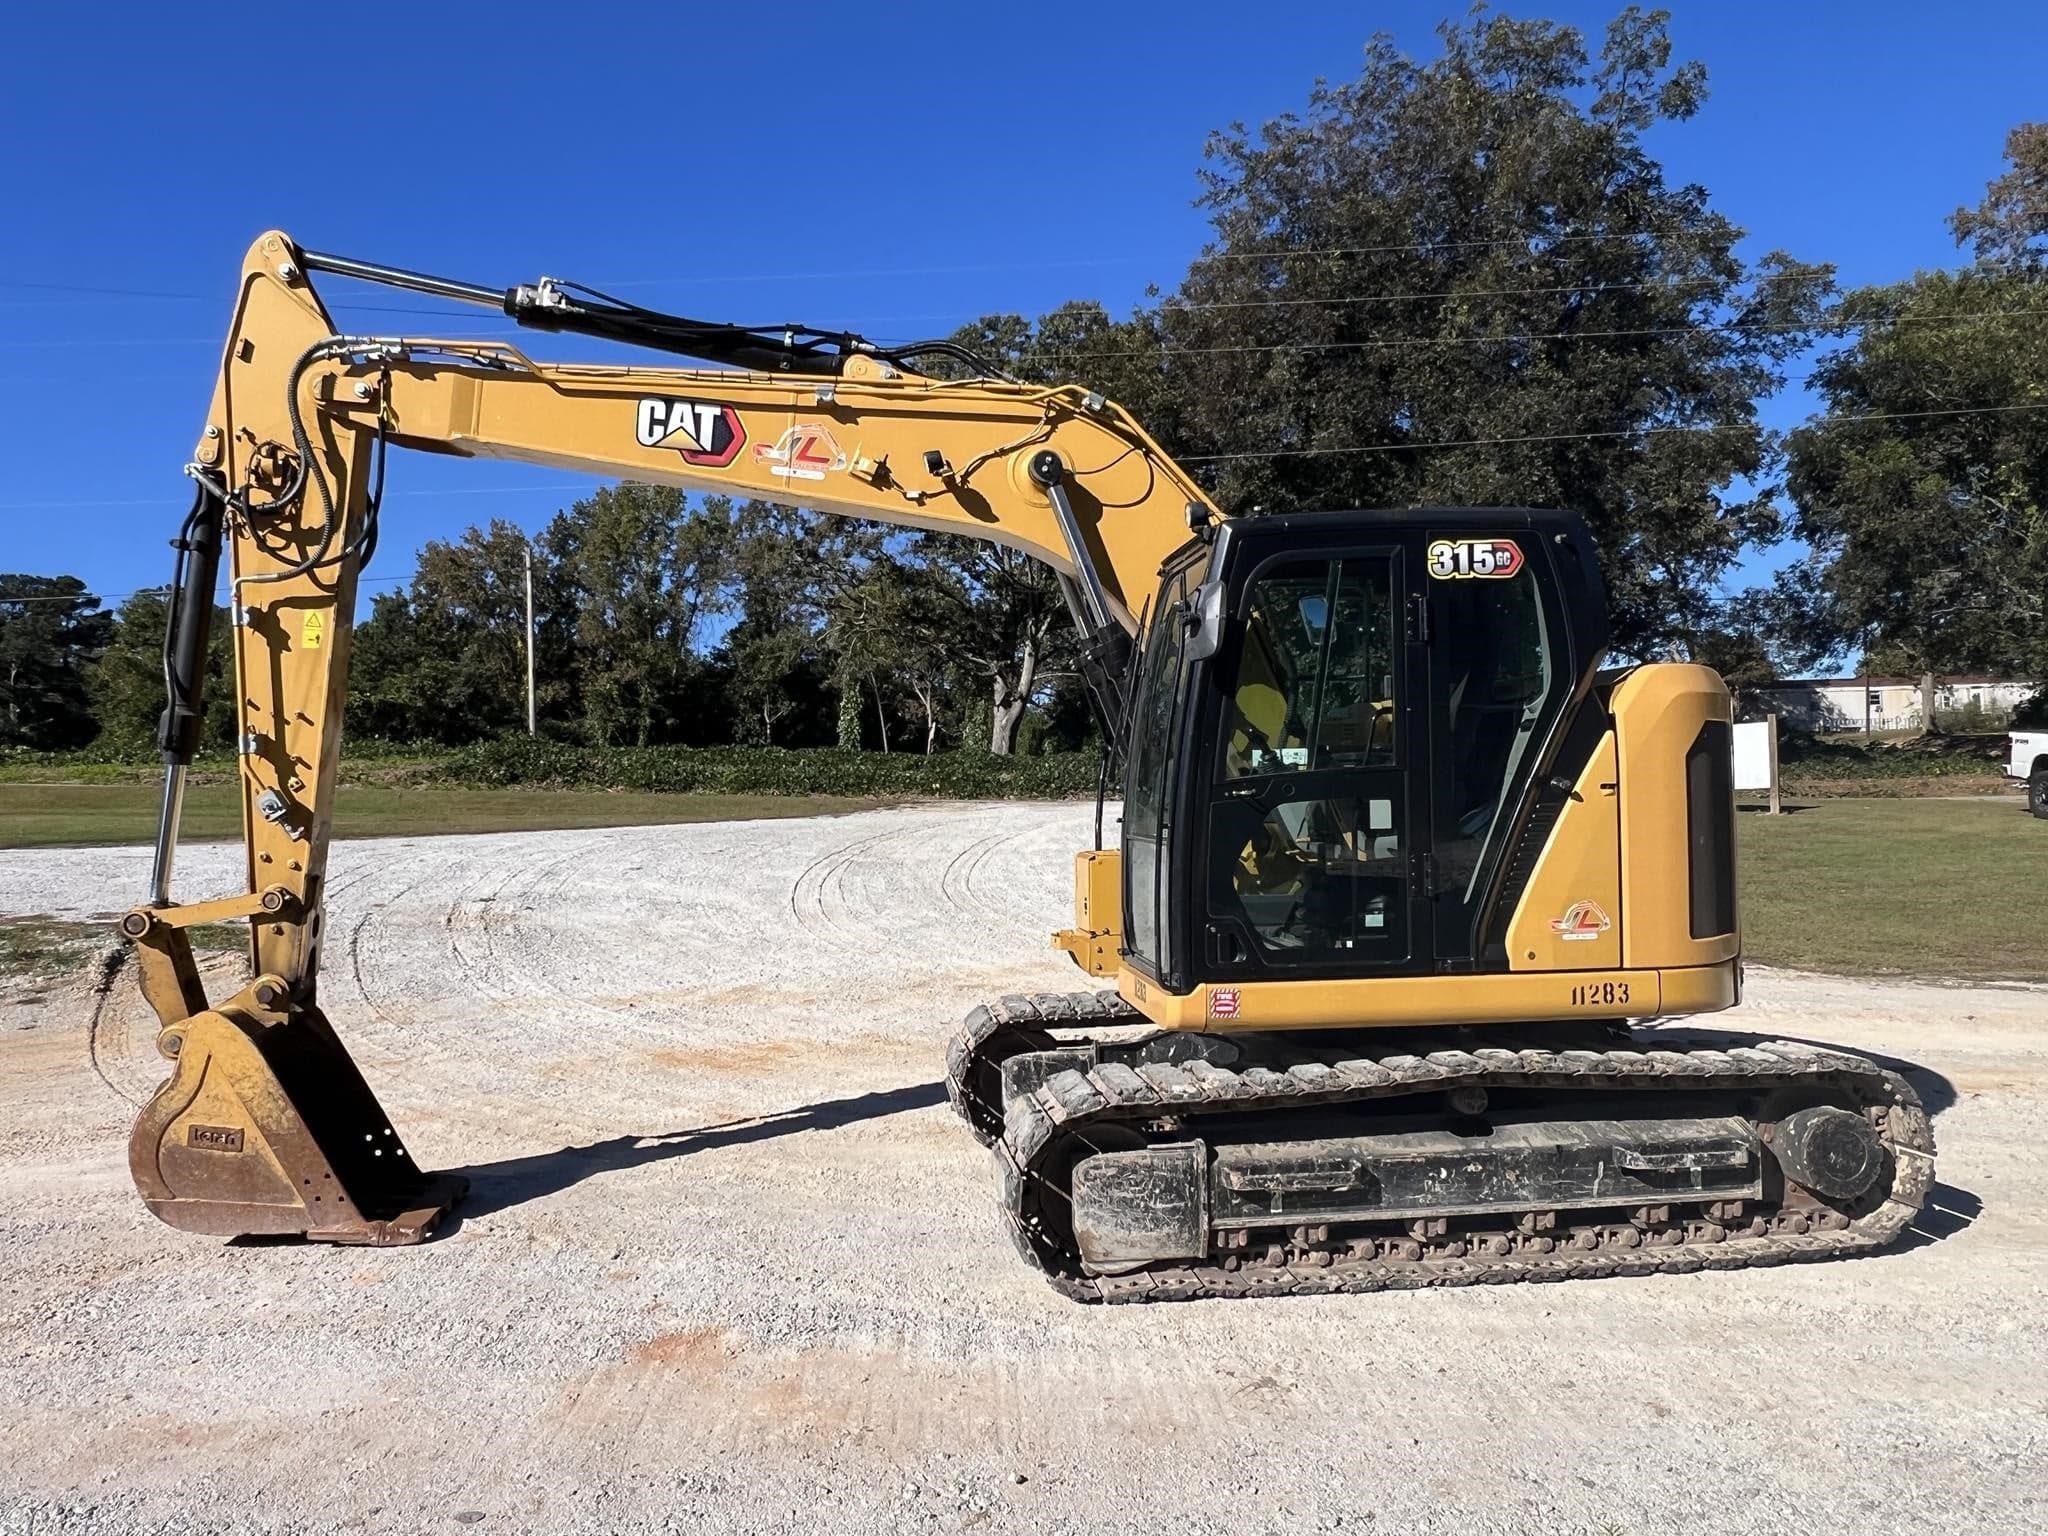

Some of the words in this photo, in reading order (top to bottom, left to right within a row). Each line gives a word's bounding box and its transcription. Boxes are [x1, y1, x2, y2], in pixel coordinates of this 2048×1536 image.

[637, 397, 722, 452] CAT
[1431, 543, 1495, 576] 315
[1495, 551, 1511, 566] GC
[1571, 981, 1630, 1006] 11283
